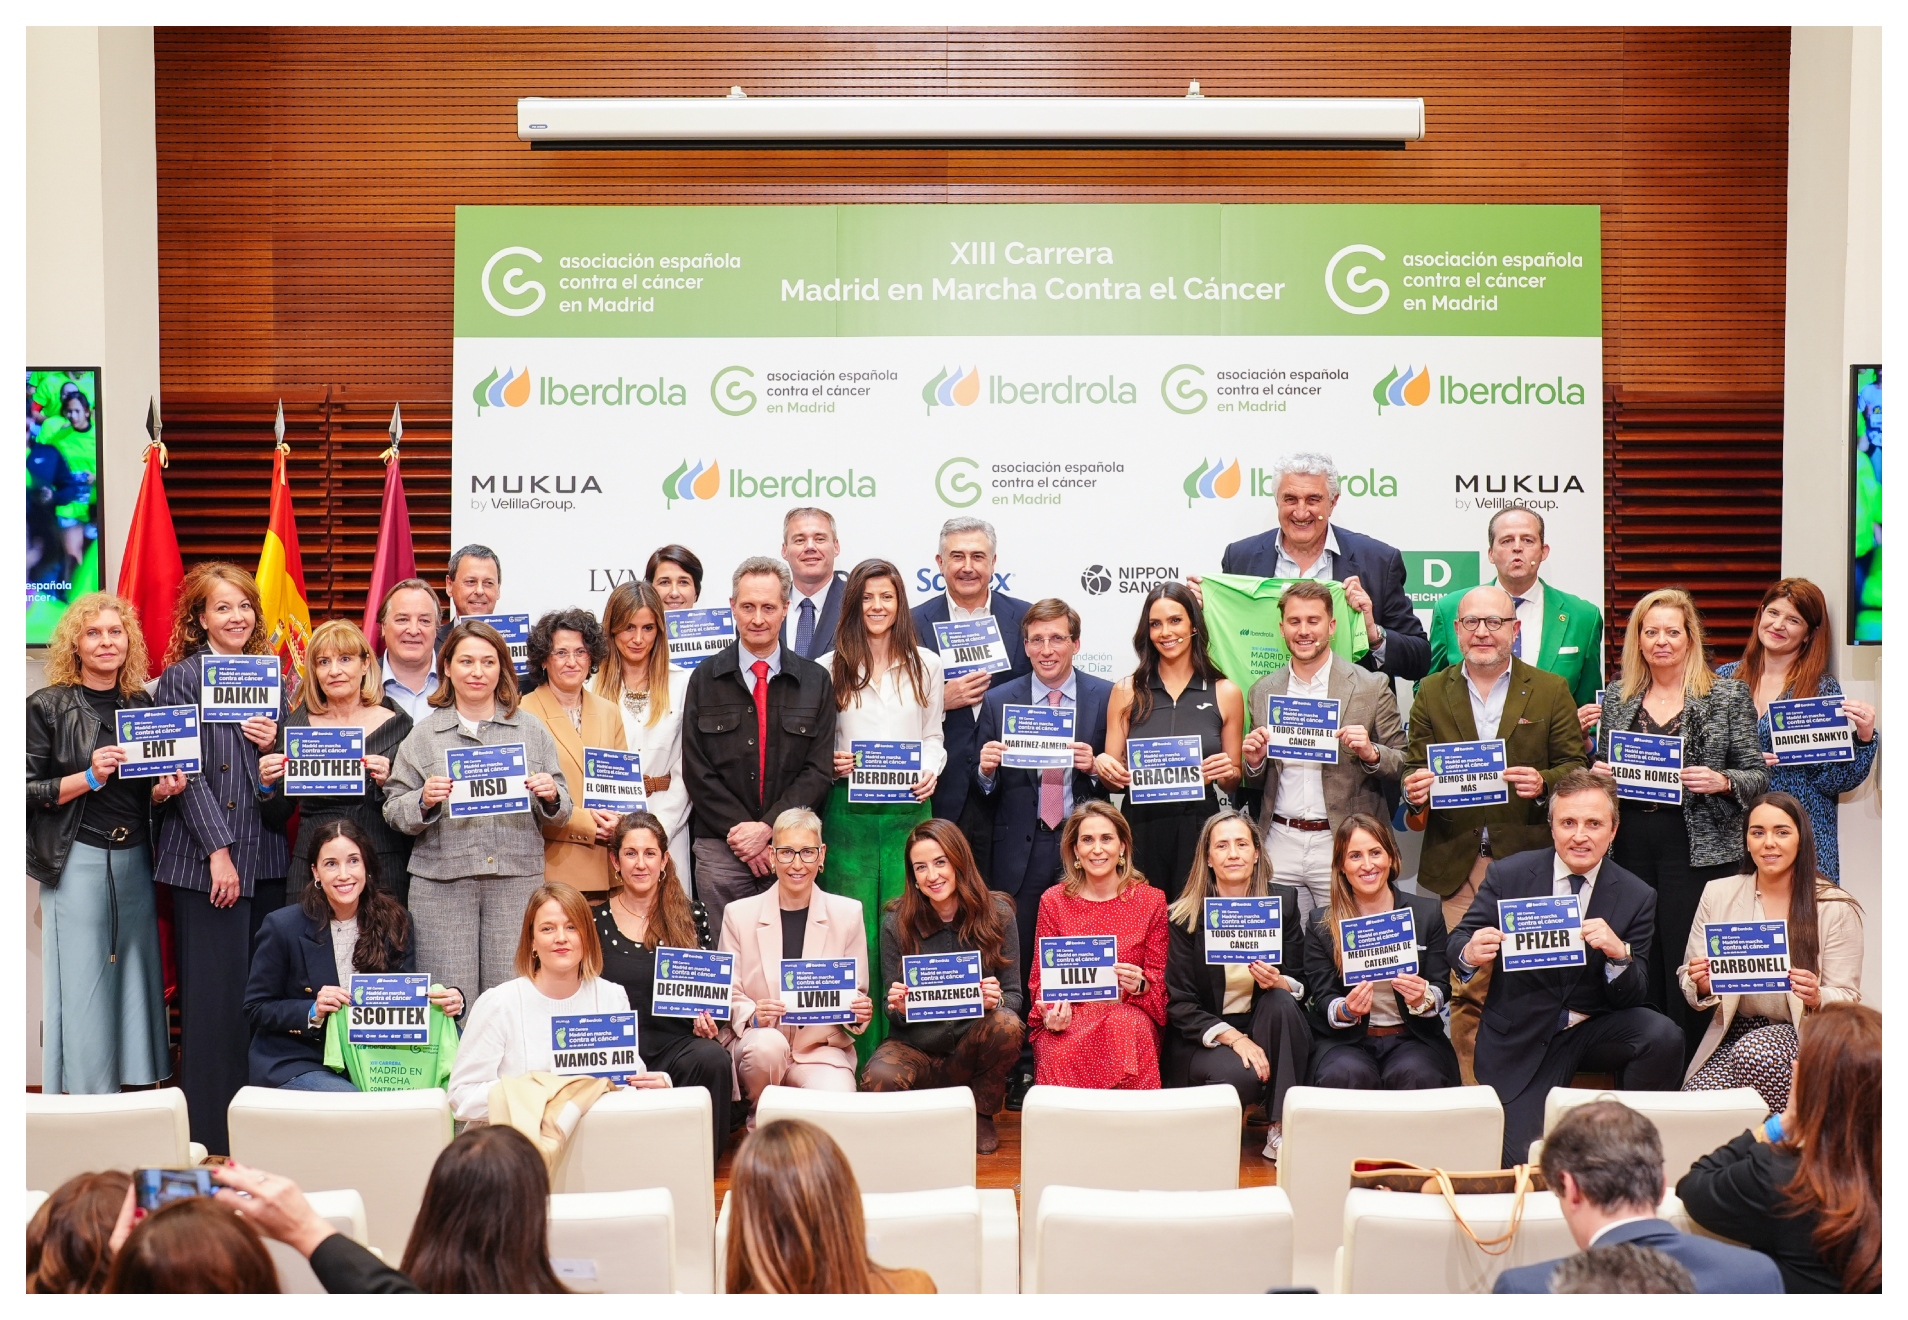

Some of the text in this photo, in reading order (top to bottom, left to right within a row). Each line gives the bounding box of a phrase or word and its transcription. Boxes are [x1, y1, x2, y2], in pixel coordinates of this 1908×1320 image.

[951, 241, 1114, 265] XIII Carrera
[560, 253, 741, 273] asociación española
[1402, 251, 1583, 271] asociación española
[560, 274, 704, 290] contra el cáncer
[1403, 273, 1546, 288] contra el cáncer
[781, 276, 1285, 302] Madrid en Marcha Contra el Cáncer
[559, 296, 655, 313] en Madrid
[1403, 294, 1498, 311] en Madrid
[767, 369, 898, 384] asociación española
[1217, 368, 1349, 383] asociación española
[539, 376, 686, 407] Iberdrola
[767, 385, 870, 397] contra el cáncer
[988, 375, 1136, 405] Iberdrola
[1217, 383, 1321, 395] contra el cáncer
[1439, 375, 1585, 405] Iberdrola
[767, 401, 835, 413] en Madrid
[1217, 400, 1286, 412] en Madrid
[992, 461, 1124, 475] asociación española
[471, 476, 603, 494] MUKUA
[730, 469, 876, 498] Iberdrola
[992, 477, 1097, 488] contra el cáncer
[1251, 468, 1397, 497] Ibrola
[1456, 475, 1584, 493] MUKUA
[471, 498, 575, 512] by VelillaGroup.
[992, 494, 1061, 504] en Madrid
[1456, 498, 1558, 511] by VelillaGroup.
[1119, 567, 1178, 579] NIPPON
[26, 581, 71, 592] española
[670, 641, 702, 652] VELILLA
[954, 645, 992, 663] JAIME
[1251, 652, 1283, 660] MADRID
[1089, 663, 1112, 672] Díaz
[214, 687, 268, 704] DAIKIN
[1273, 726, 1294, 734] TODOS
[1297, 727, 1323, 736] CONTRA
[1775, 731, 1848, 745] DAIICHI SANKYO
[143, 740, 176, 758] EMT
[1289, 737, 1315, 746] CÁNCER
[288, 760, 361, 776] BROTHER
[1612, 766, 1678, 783] AEDAS HOMES
[852, 772, 919, 784] IBERDROLA
[1133, 766, 1200, 786] GRACIAS
[1439, 774, 1464, 783] DEMOS
[1479, 772, 1498, 780] PASO
[470, 778, 507, 797] MSD
[587, 783, 593, 792] EL
[596, 784, 616, 794] CORTE
[1461, 784, 1477, 792] MÁS
[1238, 930, 1267, 938] CONTRA
[1516, 930, 1570, 950] PFIZER
[1230, 940, 1258, 949] CÁNCER
[1404, 941, 1411, 949] DE
[1365, 956, 1399, 968] CATERING
[1711, 958, 1787, 974] CARBONELL
[1061, 968, 1097, 984] LILLY
[657, 983, 728, 1000] DEICHMANN
[908, 987, 979, 1002] ASTRAZENECA
[798, 991, 840, 1008] LVMH
[353, 1007, 425, 1025] SCOTTEX
[554, 1050, 634, 1068] WAMOS AIR
